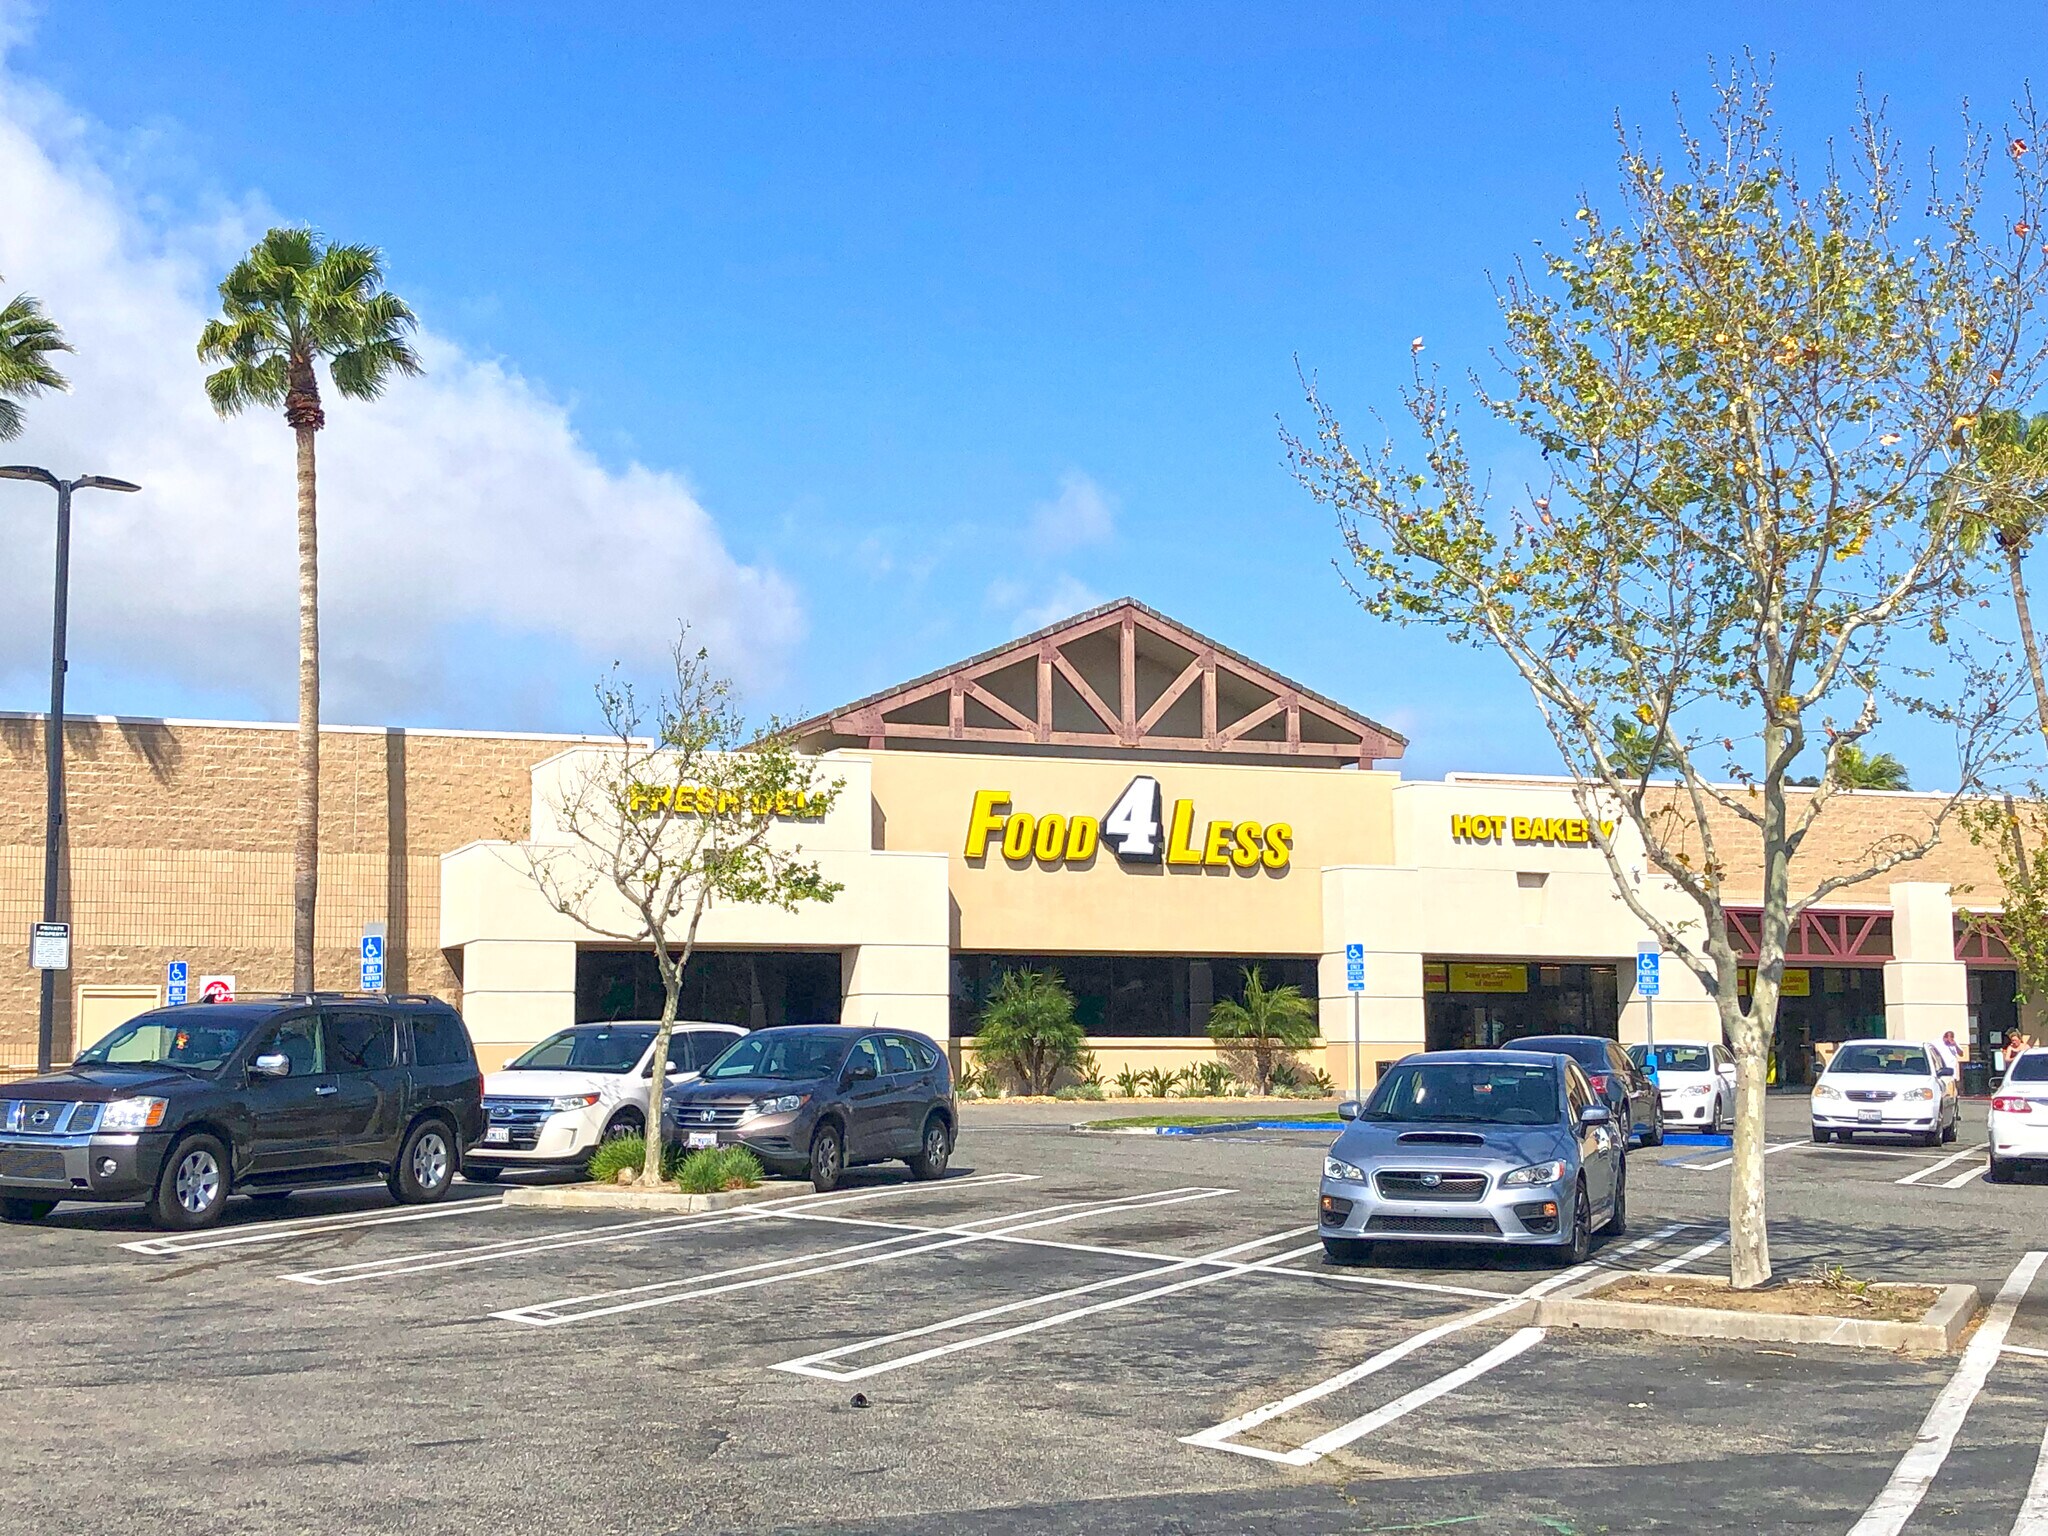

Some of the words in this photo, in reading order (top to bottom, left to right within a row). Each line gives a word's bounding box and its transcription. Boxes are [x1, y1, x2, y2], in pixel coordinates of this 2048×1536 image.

[964, 790, 1098, 861] FOOD
[1101, 775, 1163, 865] 4
[1166, 799, 1293, 868] LESS
[1452, 815, 1506, 838] HOT
